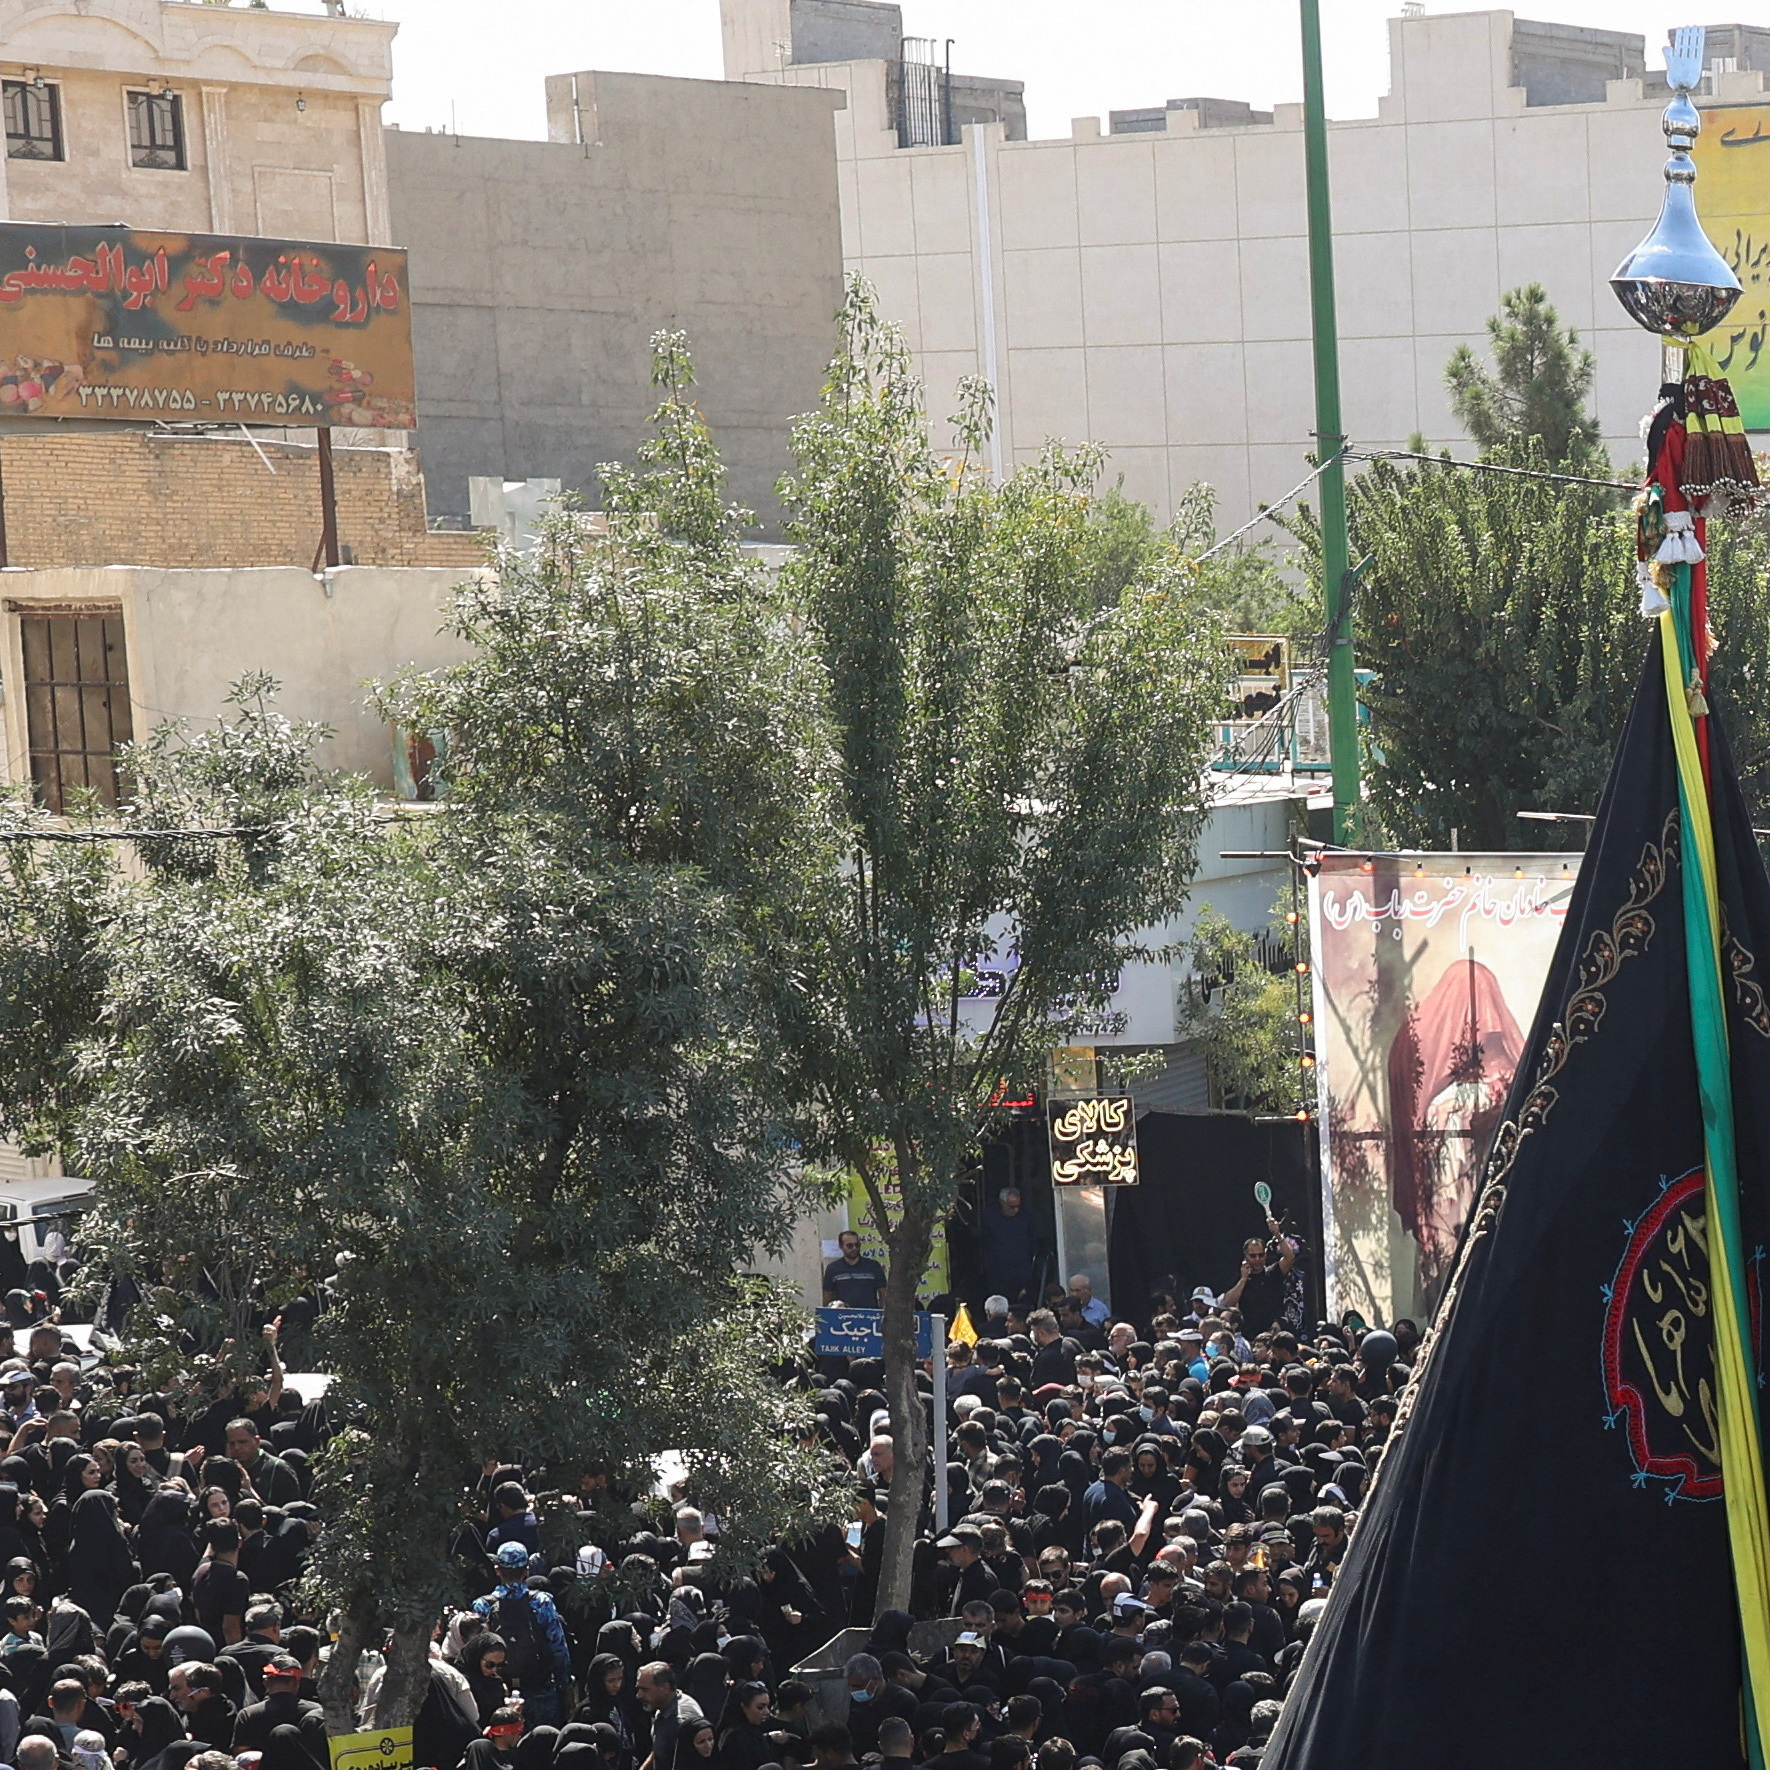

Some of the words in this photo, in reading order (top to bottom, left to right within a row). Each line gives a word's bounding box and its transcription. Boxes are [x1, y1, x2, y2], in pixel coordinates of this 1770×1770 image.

[0, 241, 168, 310] ابوالحسنی
[175, 250, 254, 311] دکتر
[261, 255, 400, 323] داروخانه
[92, 331, 114, 349] ها
[118, 333, 154, 353] بیمه
[212, 338, 271, 358] قرارداد
[274, 342, 317, 359] طرف
[77, 384, 197, 409] ۳۳۳۷۸۷۵۵
[216, 388, 324, 416] ۳۳۷۴۵۶۸۰
[1402, 877, 1467, 928] حضرت
[1054, 1099, 1128, 1141] کالای
[1053, 1140, 1137, 1184] پزشکی
[830, 1321, 883, 1342] اجیک
[842, 1345, 866, 1354] ALLEY
